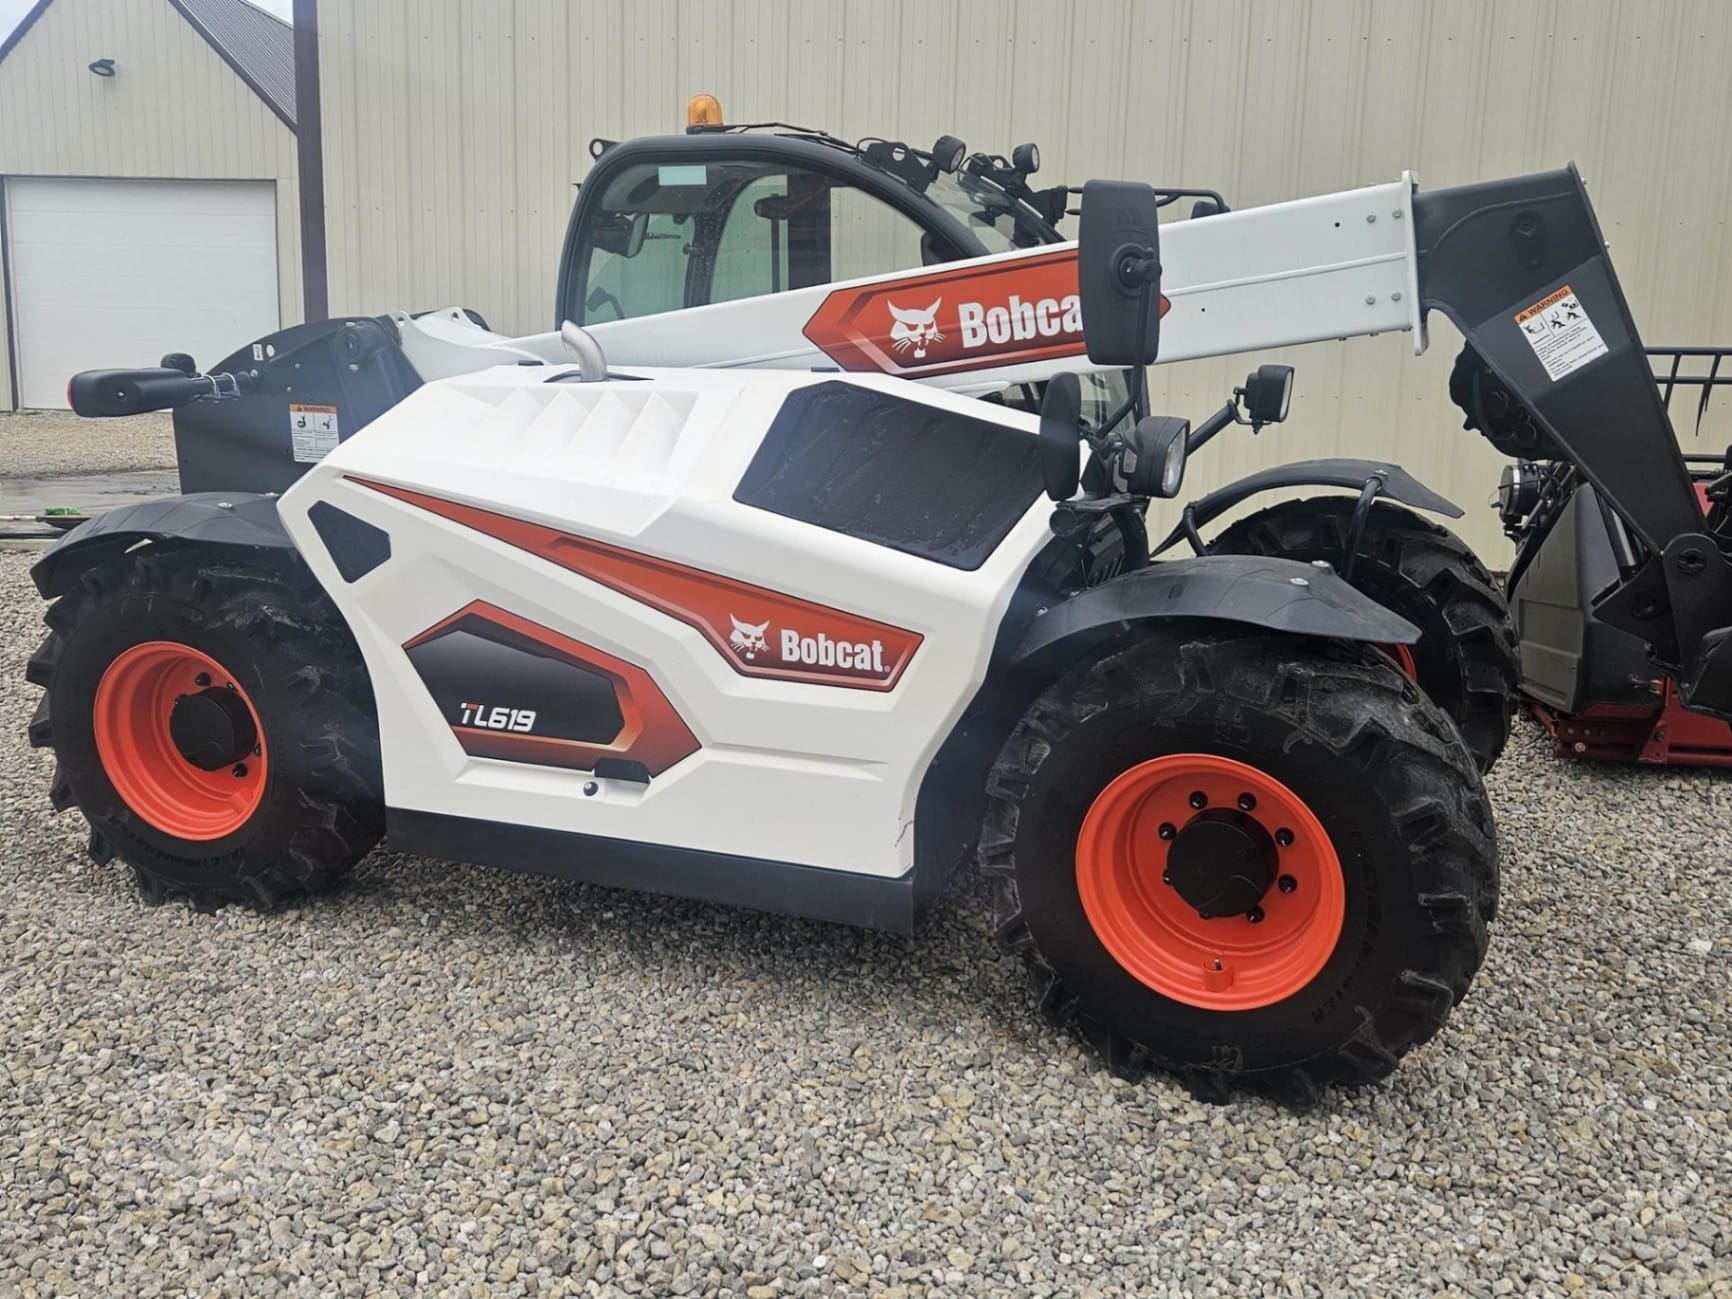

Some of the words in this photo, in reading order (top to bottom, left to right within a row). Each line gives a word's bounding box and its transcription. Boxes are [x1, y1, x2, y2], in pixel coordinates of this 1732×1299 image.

[1528, 289, 1569, 316] WARNING
[957, 295, 1083, 349] Bobca
[780, 629, 884, 672] Bobcat
[460, 702, 537, 732] TL619
